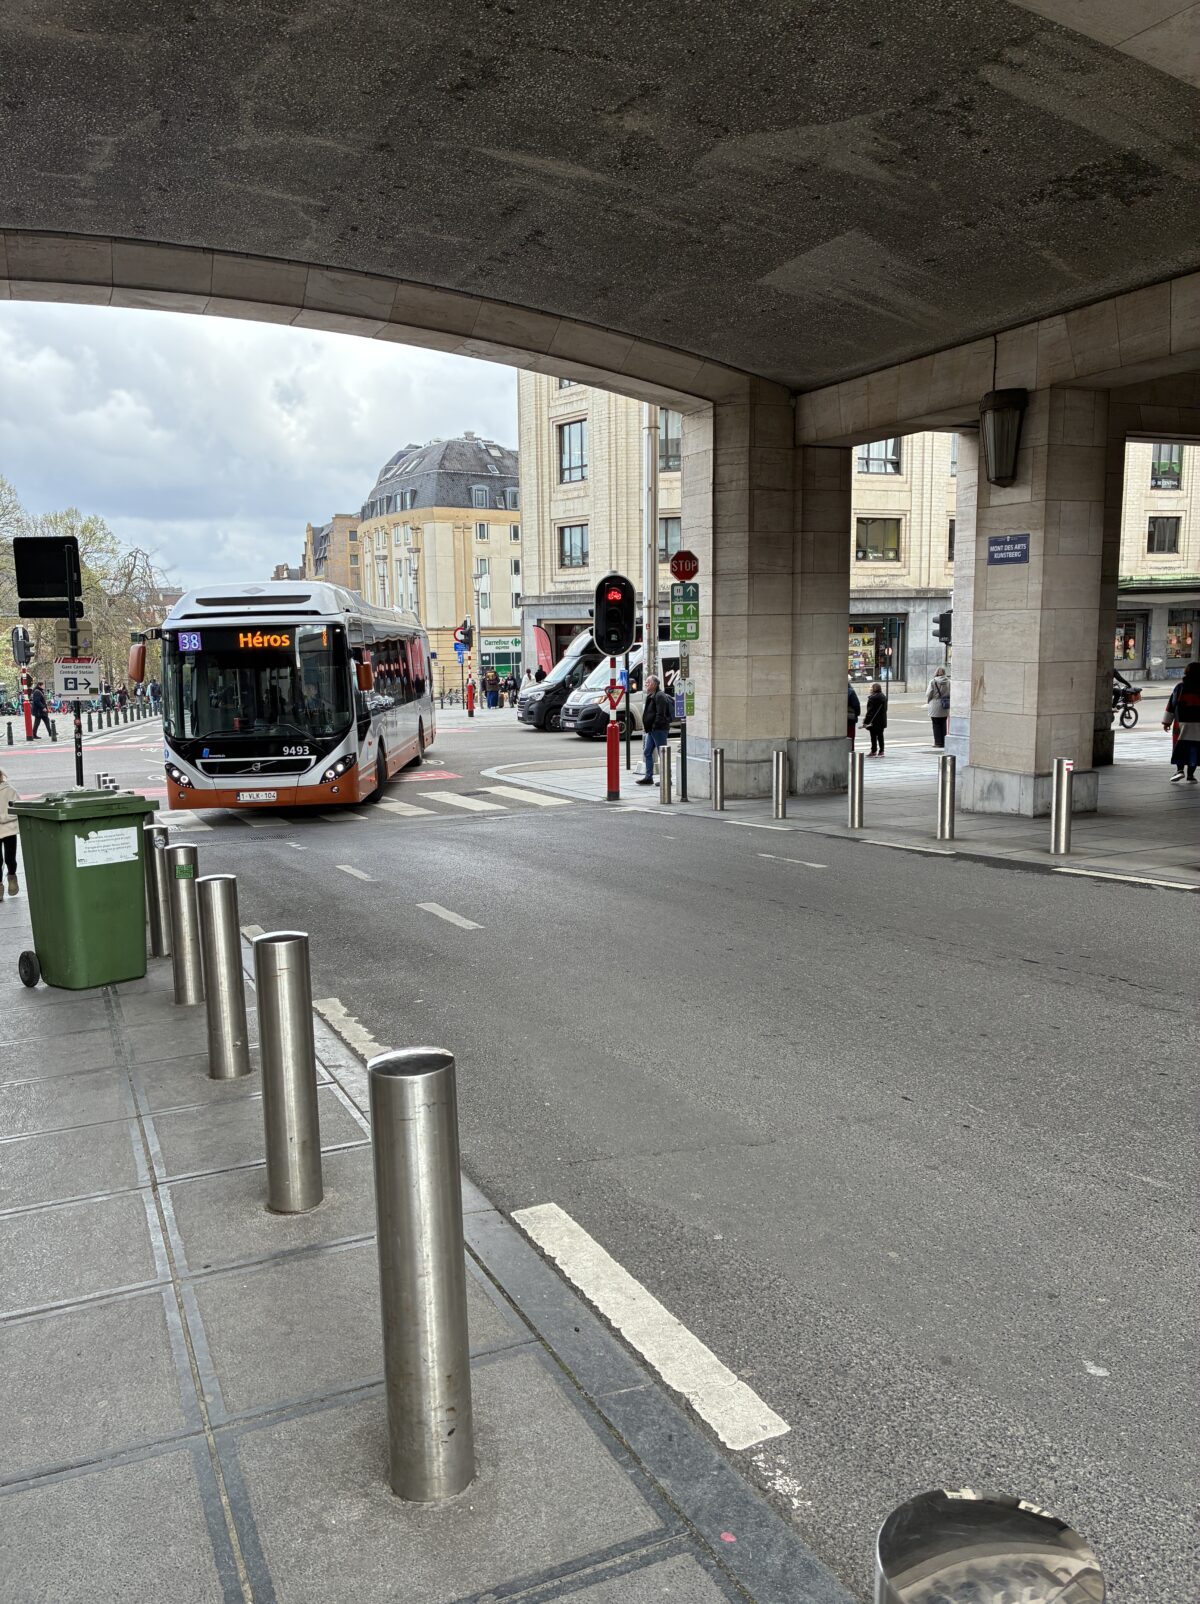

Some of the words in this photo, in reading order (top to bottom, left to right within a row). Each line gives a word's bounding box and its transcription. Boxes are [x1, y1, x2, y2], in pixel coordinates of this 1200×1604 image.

[994, 551, 1022, 559] KUNSTBERG
[672, 560, 697, 572] STOP
[181, 634, 199, 649] 38
[239, 631, 290, 648] Héros
[282, 745, 309, 755] 9493
